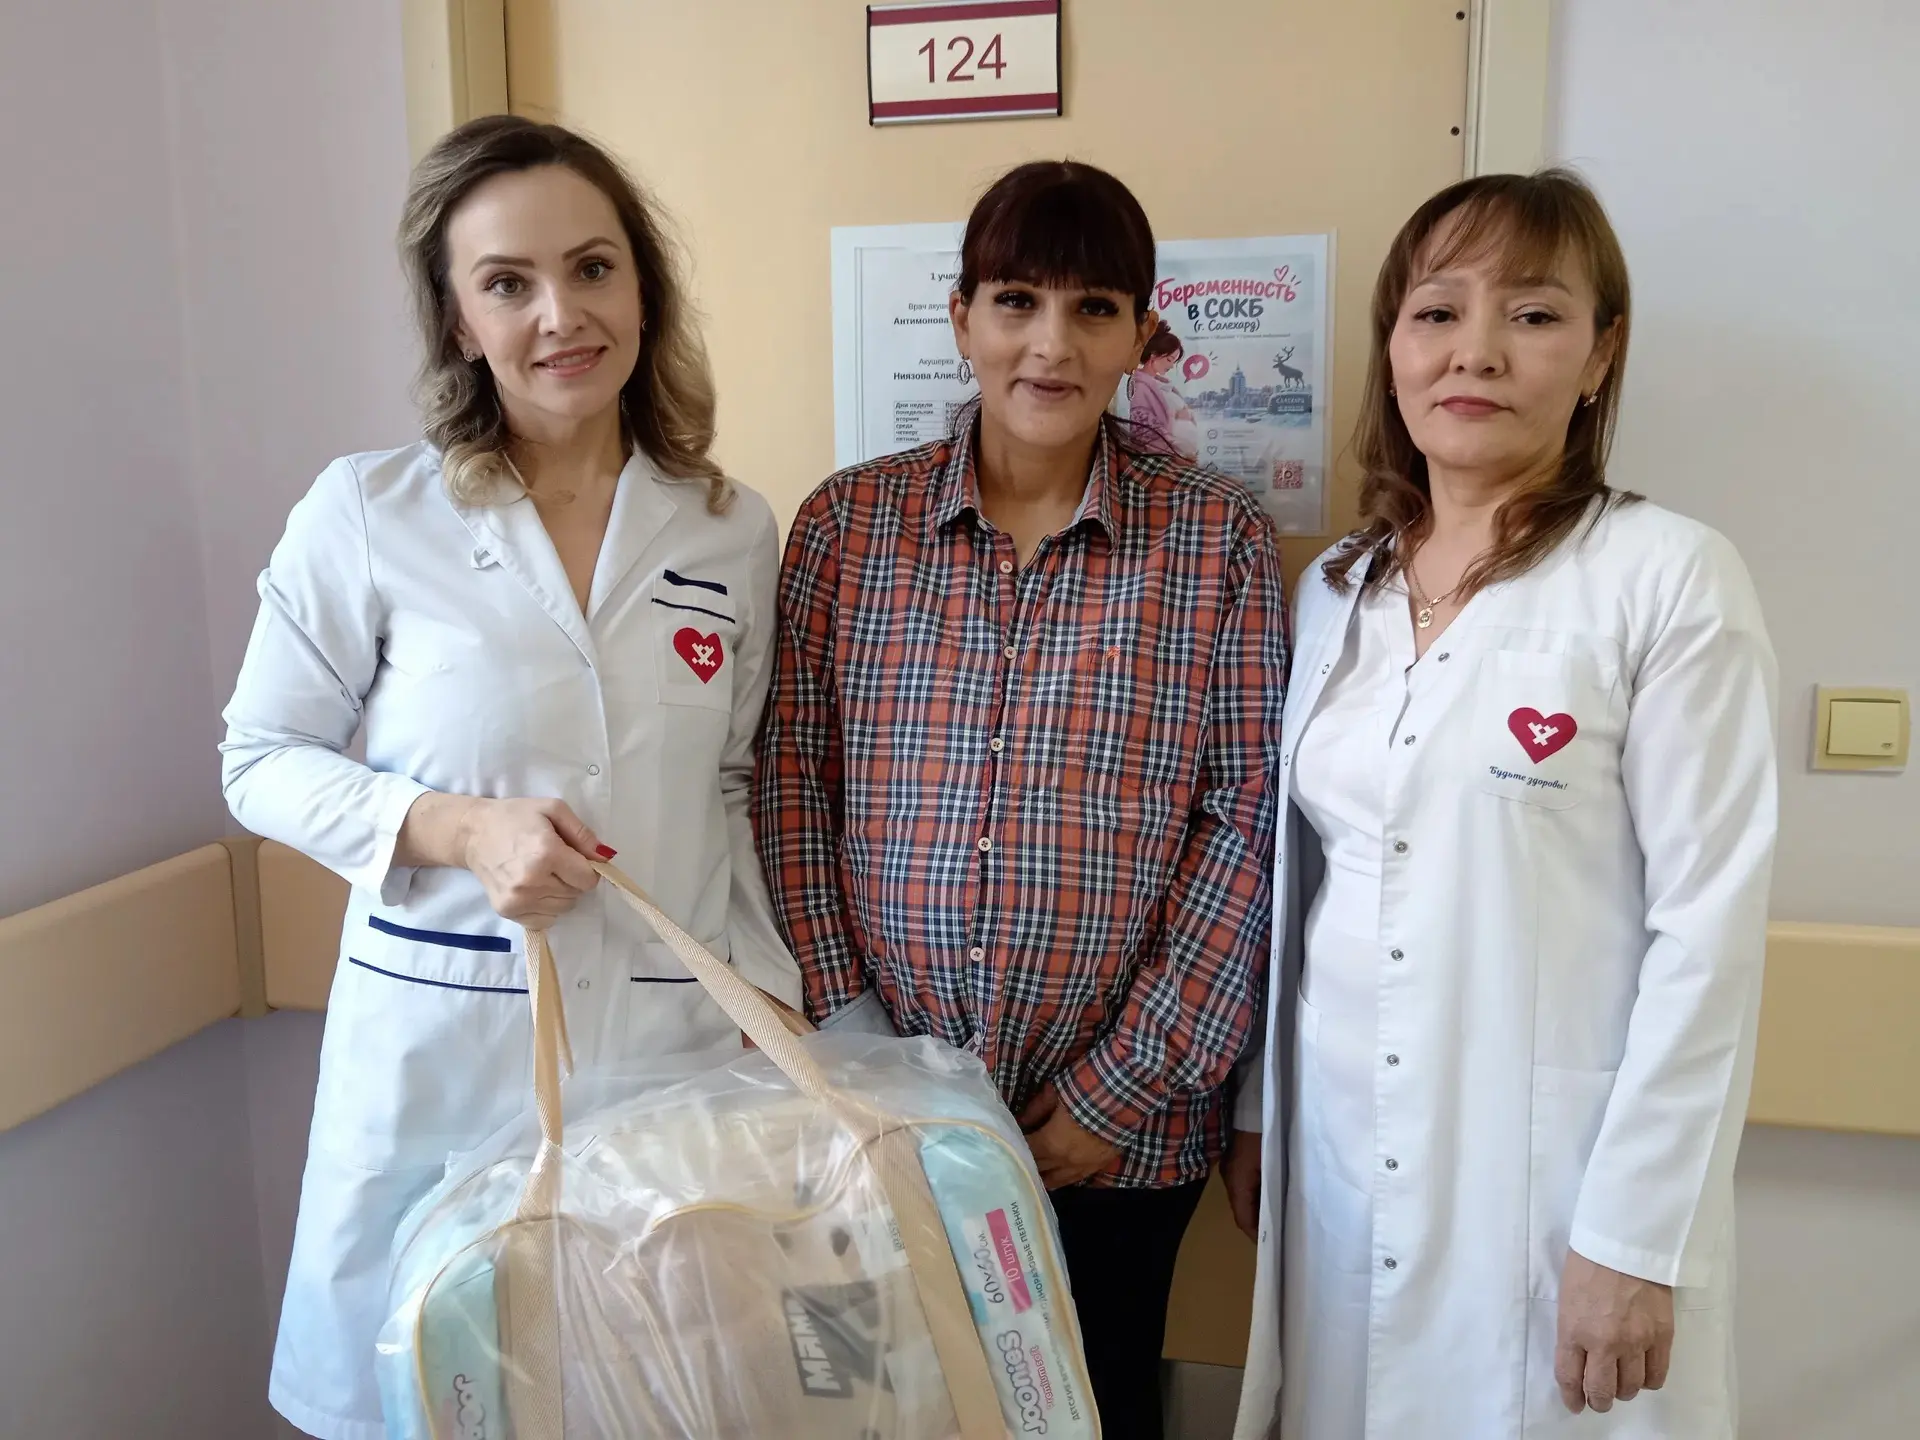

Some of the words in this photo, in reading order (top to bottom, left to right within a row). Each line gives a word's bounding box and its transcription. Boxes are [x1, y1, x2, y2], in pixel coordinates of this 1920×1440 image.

[918, 33, 1007, 83] 124
[930, 272, 936, 281] 1
[938, 272, 959, 281] учас
[1155, 277, 1297, 310] Беременность
[908, 302, 927, 311] Врач
[929, 303, 949, 312] акуш
[1204, 298, 1264, 318] СОКБ
[893, 317, 949, 325] Антимонова
[1193, 319, 1204, 332] (г.
[1207, 318, 1260, 333] Салехард)
[918, 358, 954, 366] Акушерка
[893, 372, 931, 380] Ниязова
[1489, 765, 1526, 781] Будьте
[1526, 776, 1568, 790] здоровы!
[1000, 1236, 1016, 1265] штук
[1005, 1267, 1021, 1283] 10
